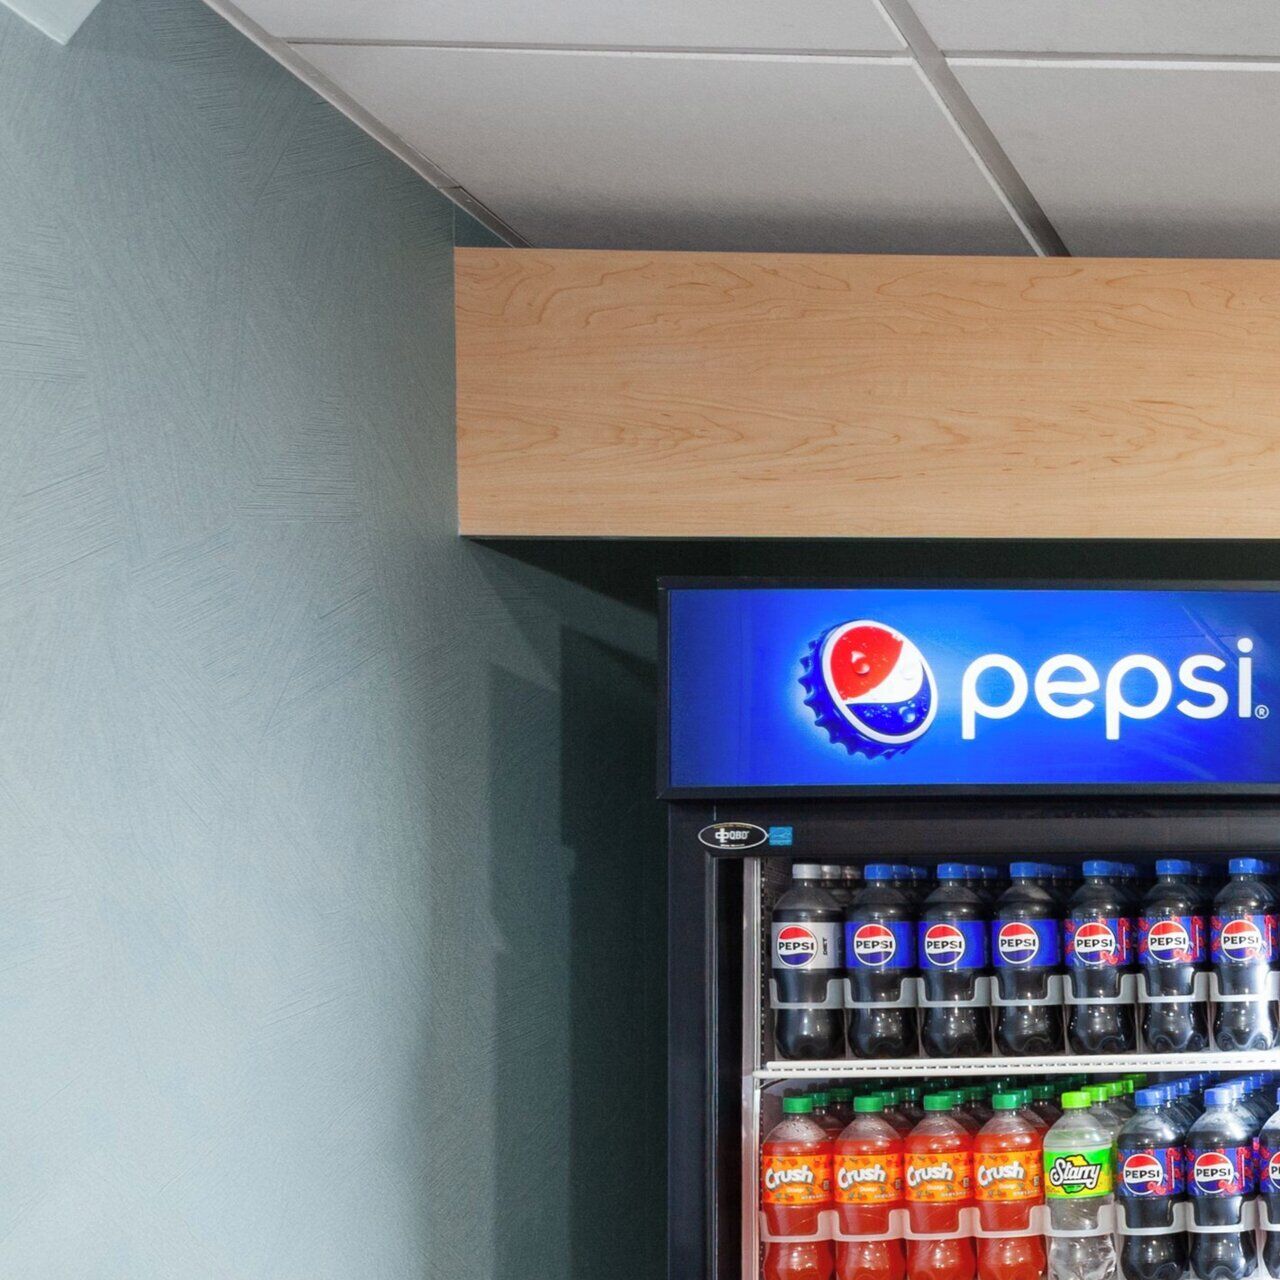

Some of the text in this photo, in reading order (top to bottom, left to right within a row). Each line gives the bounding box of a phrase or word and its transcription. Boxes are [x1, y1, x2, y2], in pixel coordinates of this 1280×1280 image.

[961, 637, 1253, 740] pepsi
[856, 940, 893, 949] PEPSI
[927, 940, 962, 949] PEPSI
[1000, 939, 1036, 948] PEPSI
[1076, 939, 1113, 947] PEPSI
[1150, 937, 1186, 946] PEPSI
[1223, 936, 1259, 945] PEPSI
[778, 942, 815, 951] PEPSI
[766, 1165, 814, 1189] Crush
[838, 1164, 886, 1189] Crush
[907, 1162, 953, 1186] Crush
[978, 1161, 1024, 1186] Crush
[1051, 1159, 1100, 1189] Starry
[1126, 1169, 1160, 1178] PEPSI
[1196, 1168, 1231, 1177] PEPSI
